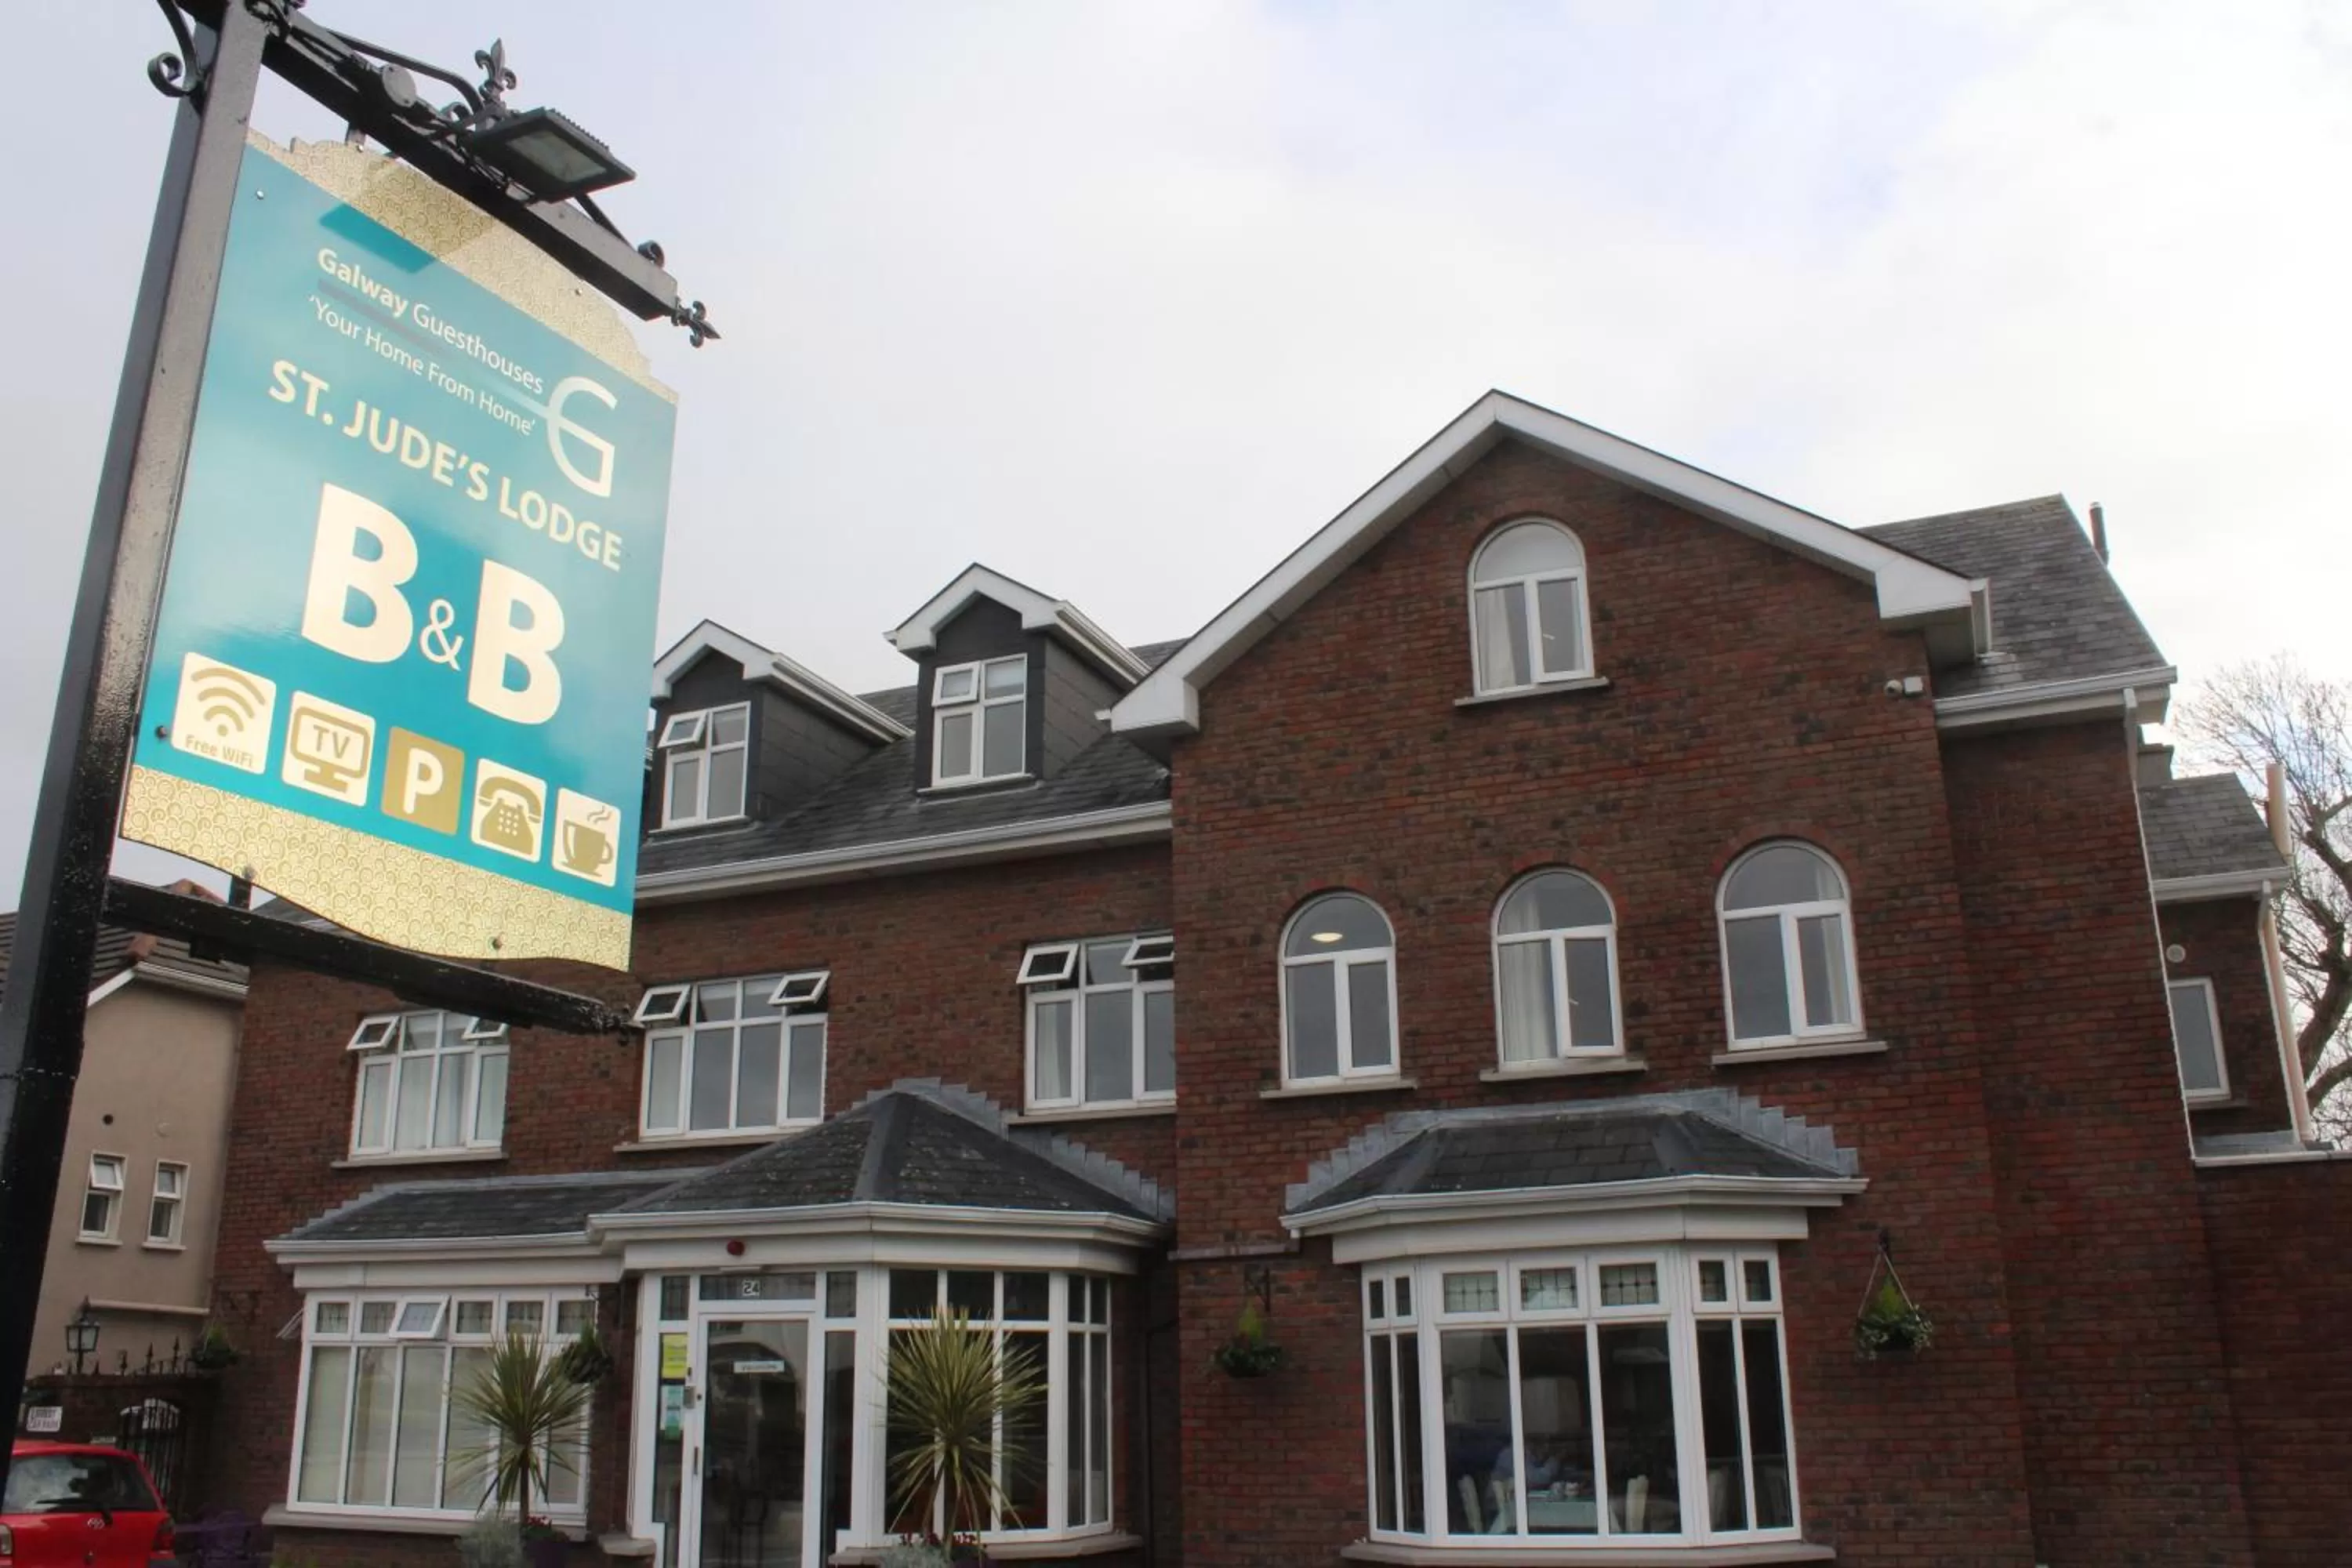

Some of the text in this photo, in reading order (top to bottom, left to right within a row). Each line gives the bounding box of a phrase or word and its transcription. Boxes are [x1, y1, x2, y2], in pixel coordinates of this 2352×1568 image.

[318, 248, 543, 394] Galway Guesthouses
[365, 331, 423, 376] Home
[428, 364, 474, 401] From
[269, 360, 622, 572] ST. JUDE'S LODGE
[185, 735, 252, 767] Free WiFi
[314, 724, 350, 759] TV
[402, 747, 445, 815] P
[744, 1281, 760, 1294] 24
